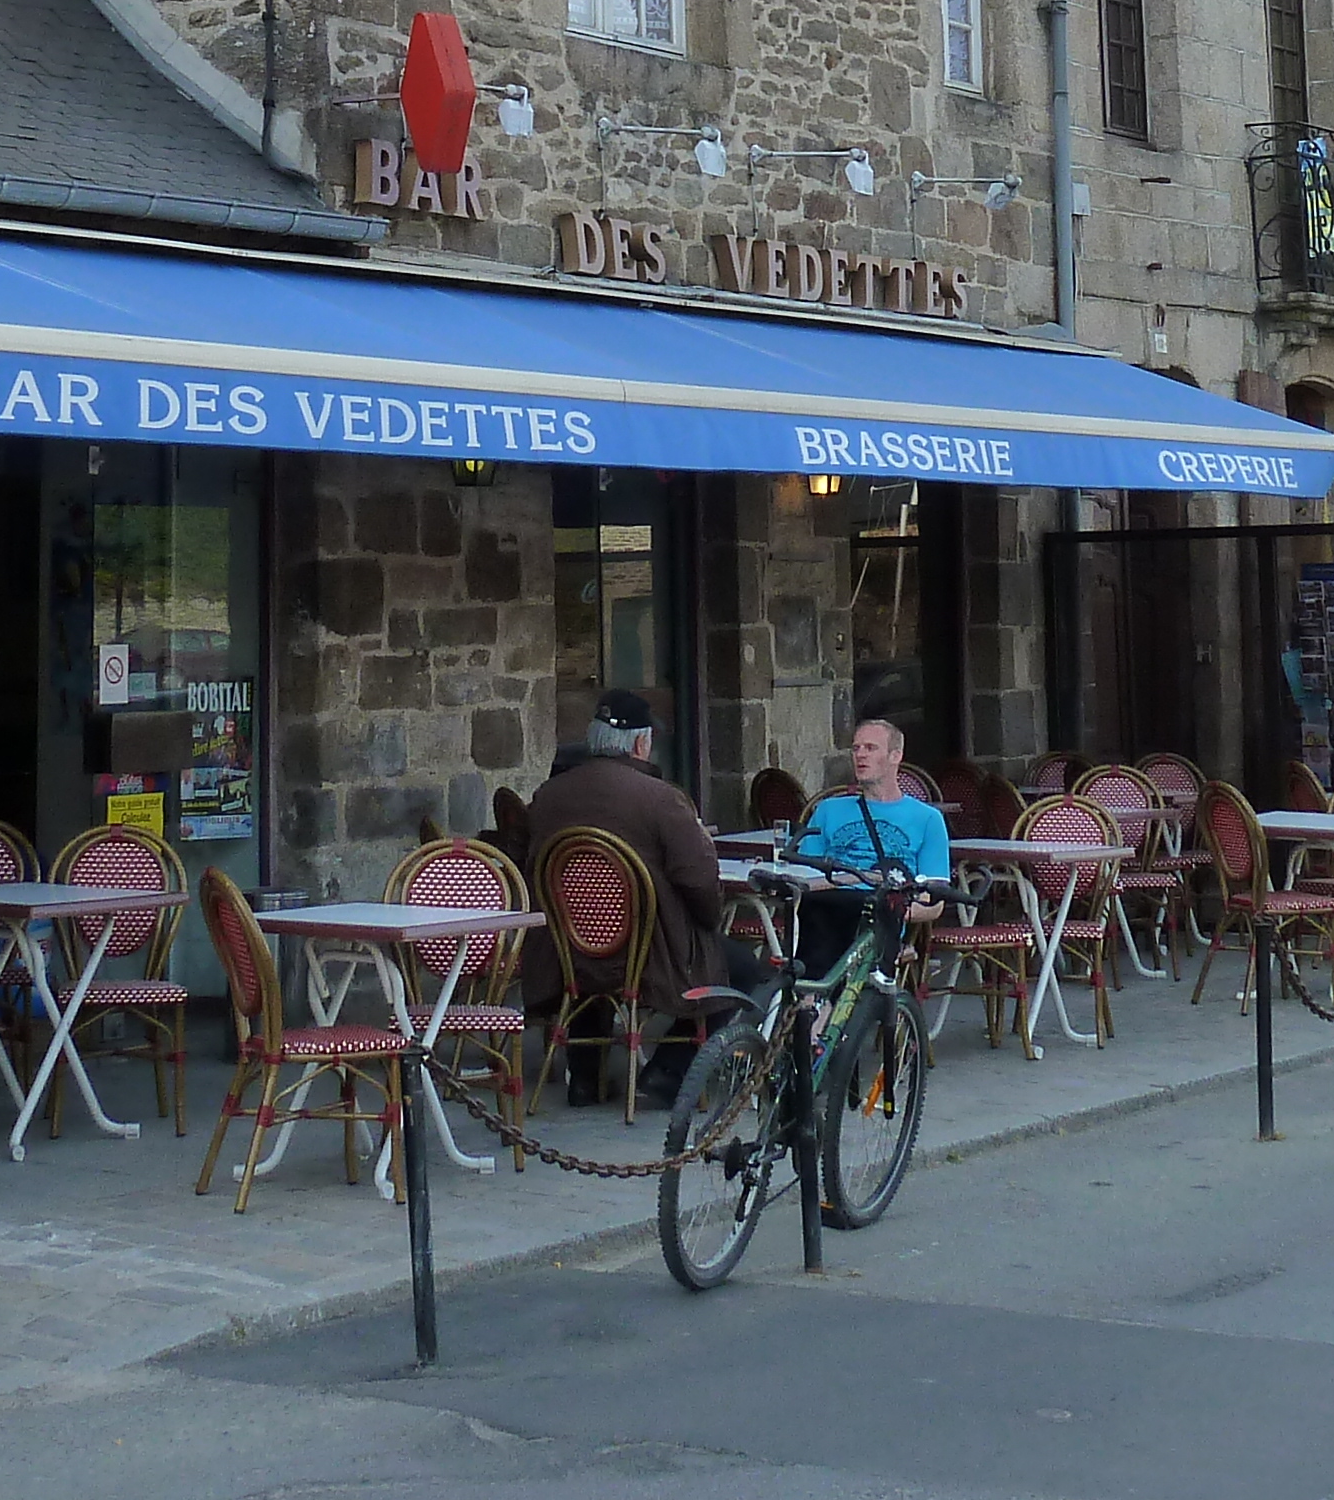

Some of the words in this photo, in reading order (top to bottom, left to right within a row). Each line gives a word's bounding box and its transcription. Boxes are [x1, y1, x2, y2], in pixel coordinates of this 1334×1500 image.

[369, 138, 485, 221] BAR
[571, 212, 668, 284] DES
[723, 235, 968, 318] VEDETTES
[137, 379, 267, 435] DES
[295, 391, 597, 454] VEDETTES
[794, 426, 1014, 477] BRASSERIE
[1158, 450, 1299, 489] CREPERIE
[187, 681, 251, 713] BOBITAL
